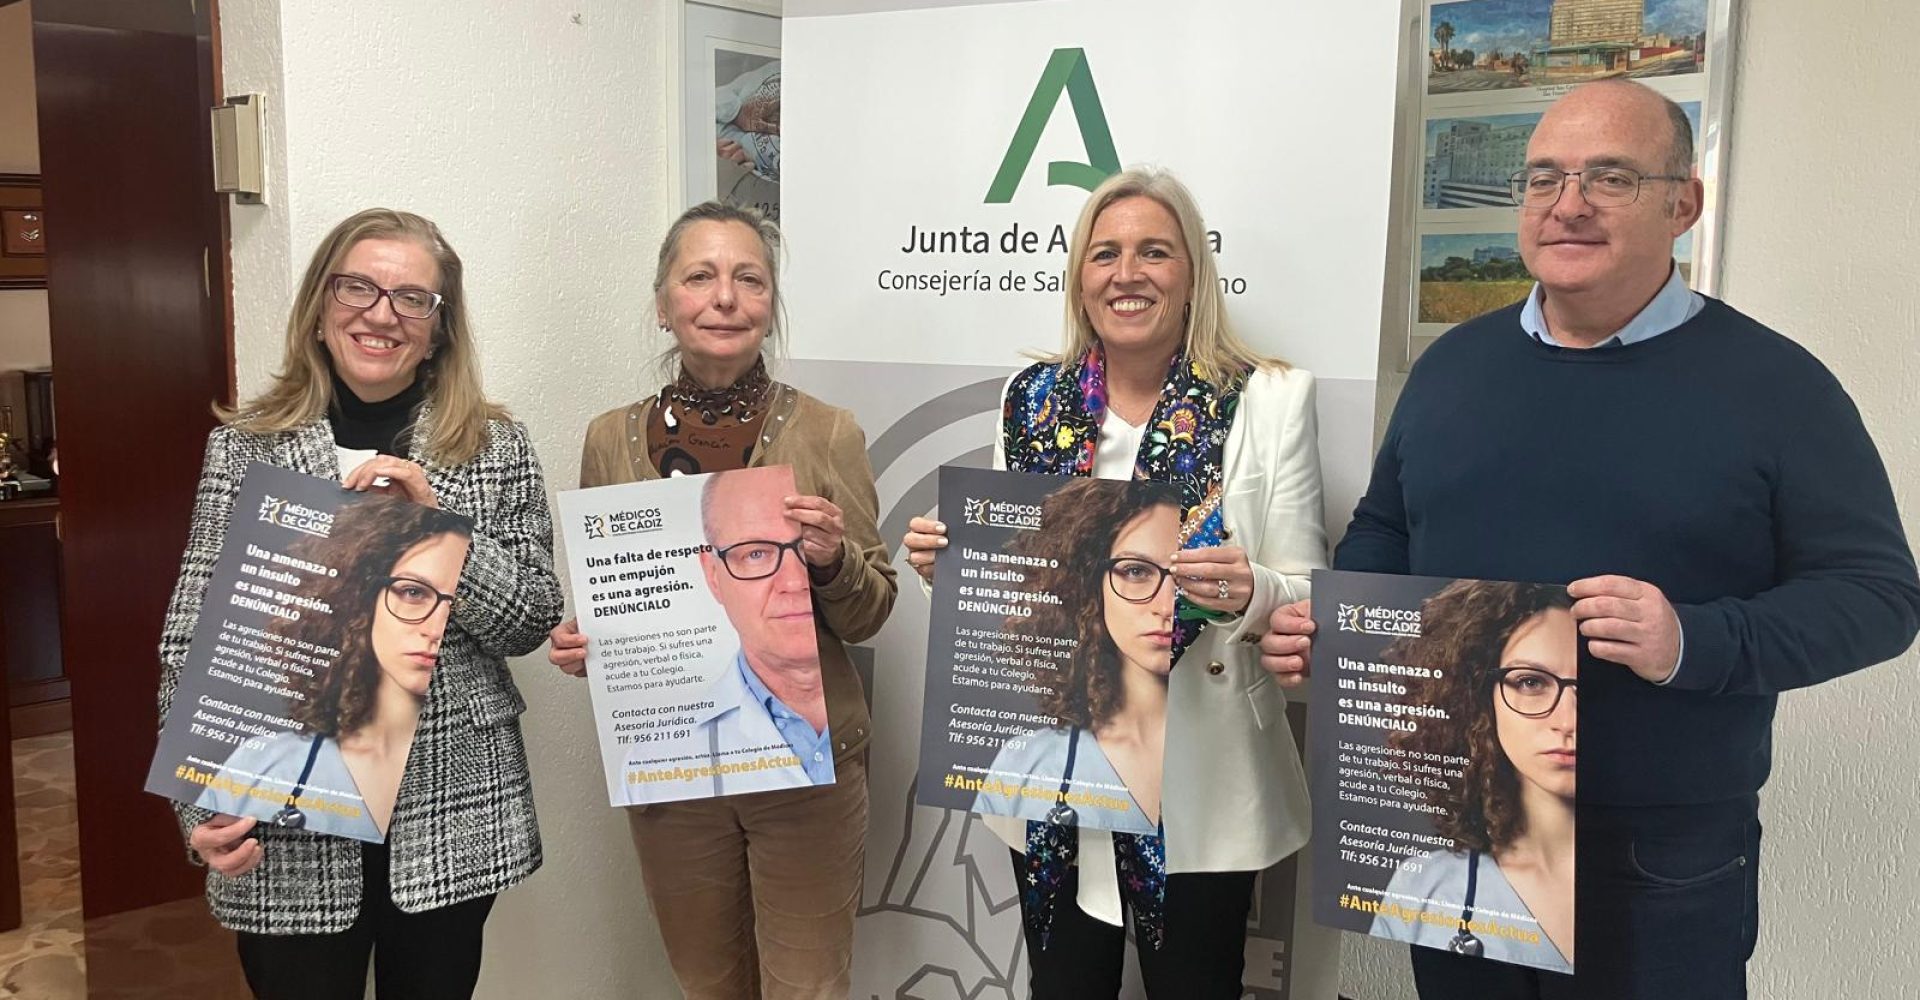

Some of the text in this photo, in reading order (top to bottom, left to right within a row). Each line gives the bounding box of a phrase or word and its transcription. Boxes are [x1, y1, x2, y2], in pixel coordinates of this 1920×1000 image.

[901, 225, 990, 254] Junta
[1000, 223, 1039, 253] de
[878, 269, 1067, 296] Consejería de Sal
[284, 503, 335, 523] MÉDICOS
[609, 508, 661, 522] MÉDICOS
[989, 501, 1042, 515] MÉDICOS
[283, 513, 297, 524] DE
[297, 517, 332, 534] CÁDIZ
[610, 523, 626, 532] DE
[628, 518, 662, 530] CÁDIZ
[989, 513, 1041, 526] DE CÁDIZ
[246, 543, 338, 577] Una amenaza o
[586, 543, 712, 567] Una falta de respeto
[962, 548, 1058, 568] Una amenaza o
[240, 563, 301, 586] un insulto
[599, 574, 616, 583] un
[618, 564, 675, 581] empujón
[960, 567, 1024, 582] un insulto
[234, 580, 332, 613] es una agresión.
[591, 580, 693, 601] es una agresión.
[959, 585, 1062, 604] es una agresión.
[230, 594, 301, 621] DENÚNCIALO
[593, 598, 671, 617] DENÚNCIALO
[958, 600, 1031, 617] DENÚNCIALO
[1364, 606, 1421, 621] MÉDICOS
[1364, 619, 1421, 633] DE CÁDIZ
[955, 626, 970, 635] Las
[972, 630, 1019, 640] agresiones
[1054, 639, 1078, 647] parte
[954, 638, 966, 647] de
[968, 640, 977, 648] tu
[979, 642, 1012, 654] trabajo.
[1015, 645, 1023, 653] Si
[1025, 647, 1051, 656] sufres
[995, 656, 1023, 666] verbal
[1338, 657, 1442, 678] Una amenaza o
[953, 664, 979, 673] acude
[989, 667, 998, 675] tu
[1000, 668, 1036, 681] Colegio.
[952, 675, 988, 687] Estamos
[990, 682, 1010, 690] para
[1338, 678, 1406, 695] un insulto
[198, 694, 303, 730] Contacta con nuestra
[950, 703, 1057, 724] Contacta con nuestra
[1338, 697, 1449, 719] es una agresión.
[948, 718, 991, 732] Asesoría
[1338, 712, 1416, 732] DENÚNCIALO
[205, 727, 226, 740] 956
[225, 732, 245, 745] 211
[948, 732, 1026, 750] Tlf: 956 211 691
[1339, 740, 1353, 750] Las
[1355, 744, 1405, 757] agresiones
[1423, 753, 1440, 761] son
[1443, 755, 1469, 765] parte
[1339, 752, 1462, 777] de tu trabajo. Si sufres una
[1339, 767, 1380, 780] agresión,
[1383, 773, 1411, 784] verbal
[1339, 780, 1366, 790] acude
[1377, 784, 1386, 792] tu
[1389, 785, 1427, 799] Colegio.
[1339, 790, 1447, 815] Estamos para ayudarte.
[1339, 819, 1454, 847] Contacta con nuestra
[1339, 834, 1384, 851] Asesoría
[1340, 849, 1422, 873] Tlf: 956 211 691
